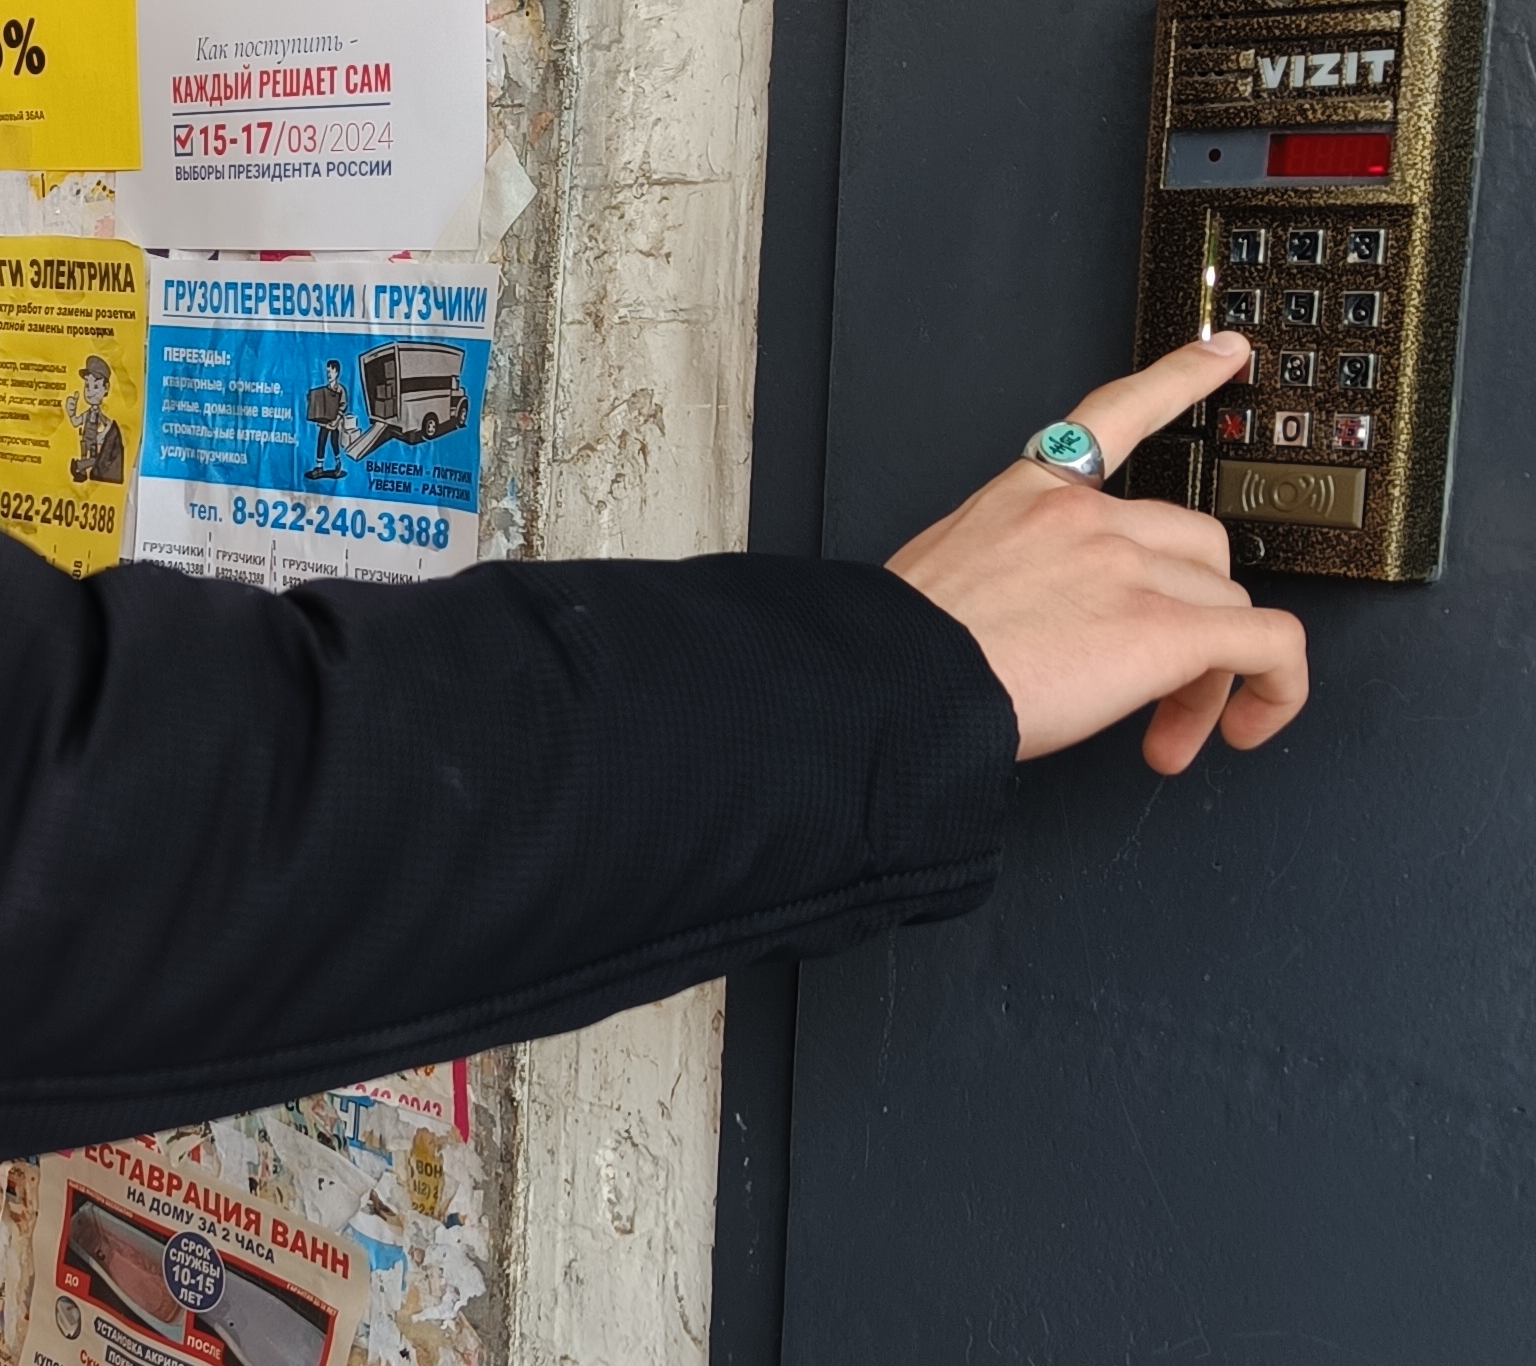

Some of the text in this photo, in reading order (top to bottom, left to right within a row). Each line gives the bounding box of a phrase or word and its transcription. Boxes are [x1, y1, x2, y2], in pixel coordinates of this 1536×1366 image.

[195, 33, 343, 65] Как поступить
[172, 63, 392, 107] КАЖДЫЙ РЕШАЕТ САМ
[1258, 49, 1395, 90] VIZIT
[199, 121, 394, 156] 15-17/03/2024
[175, 160, 392, 183] ВЫБОРЫ ПРЕЗИДЕНТА РОССИИ
[29, 259, 136, 293] ЭЛЕКТРИКА
[163, 279, 488, 324] ГРУЗОПЕРЕВОЗКИ ГРУЗЧИКИ
[163, 346, 231, 366] ПЕРЕЕЗДЫ:
[190, 496, 450, 550] тел. 8-922-240-3388
[143, 542, 204, 558] ГРУЗЧИКИ
[85, 1145, 262, 1237] ЕСТАВРАЦИЯ
[271, 1218, 350, 1280] ВАНН
[127, 1186, 146, 1207] НА
[149, 1200, 194, 1226] ДОМУ
[198, 1217, 217, 1236] ЗА
[222, 1227, 231, 1242] 2
[235, 1232, 276, 1264] ЧАСА
[169, 1247, 221, 1278] СЛУЖБЫ
[181, 1238, 212, 1260] СРОК
[65, 1273, 79, 1288] ДО
[172, 1265, 215, 1296] 10-15
[178, 1287, 203, 1307] ЛЕТ
[187, 1335, 222, 1360] ПОСЛЕ
